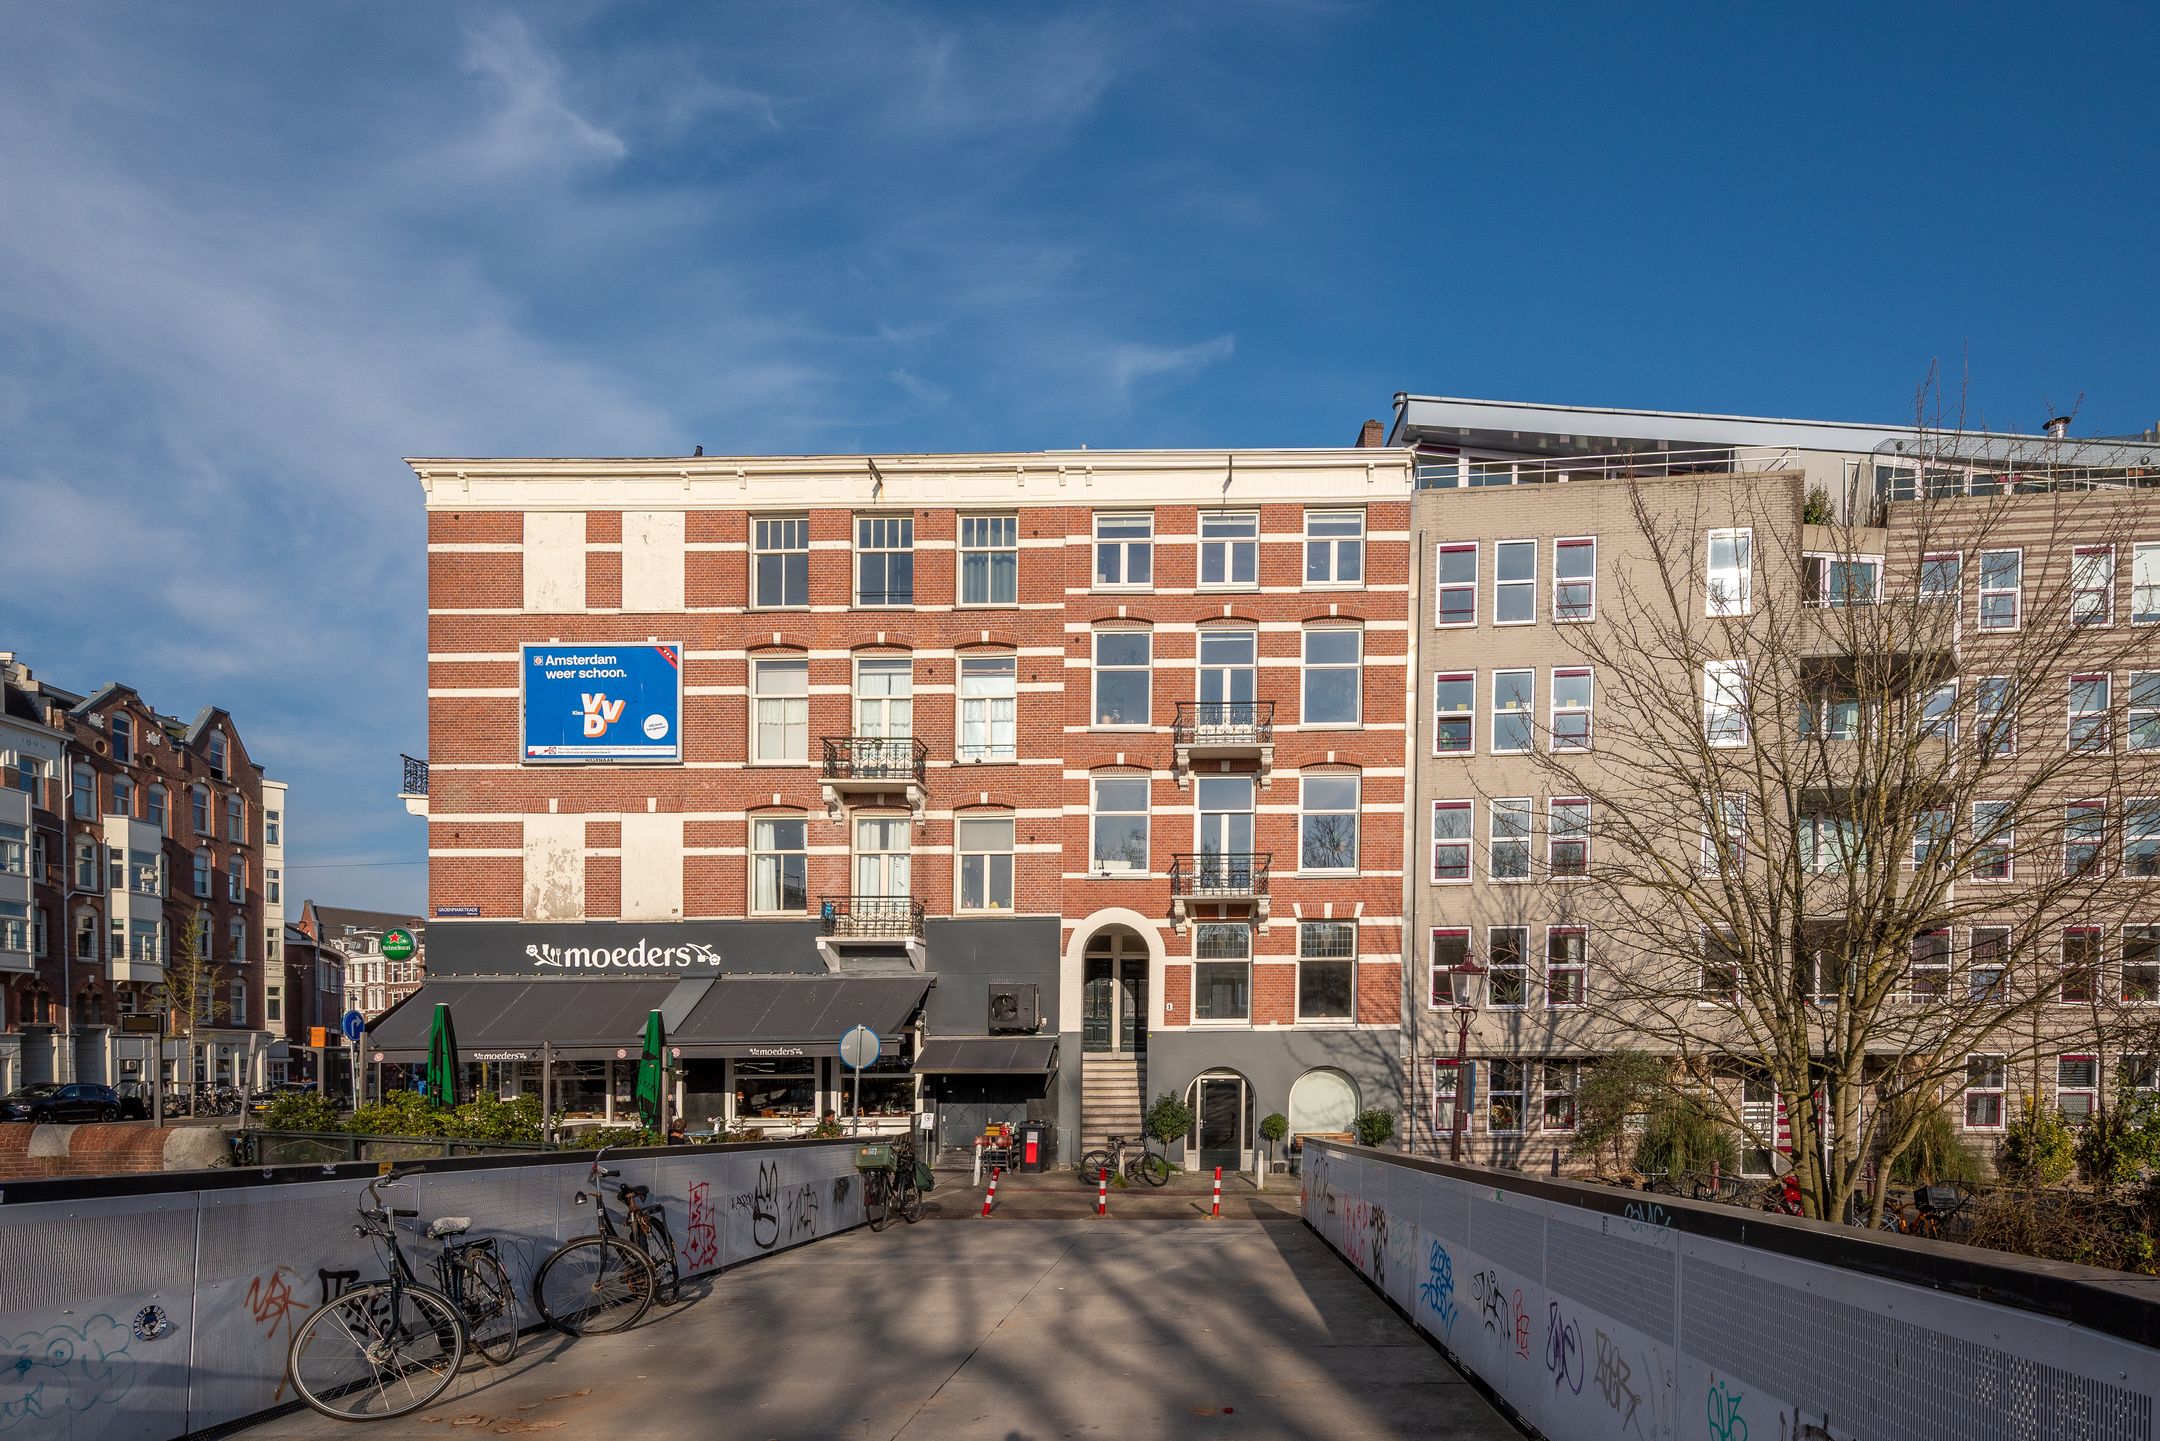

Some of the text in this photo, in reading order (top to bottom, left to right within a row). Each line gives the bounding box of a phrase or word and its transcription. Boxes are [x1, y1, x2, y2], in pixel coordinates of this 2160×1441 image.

[545, 654, 617, 666] Amsterdam
[545, 667, 628, 680] weer schoon.
[564, 938, 691, 968] moeders
[483, 1052, 518, 1060] moeders
[760, 1047, 795, 1056] moeders
